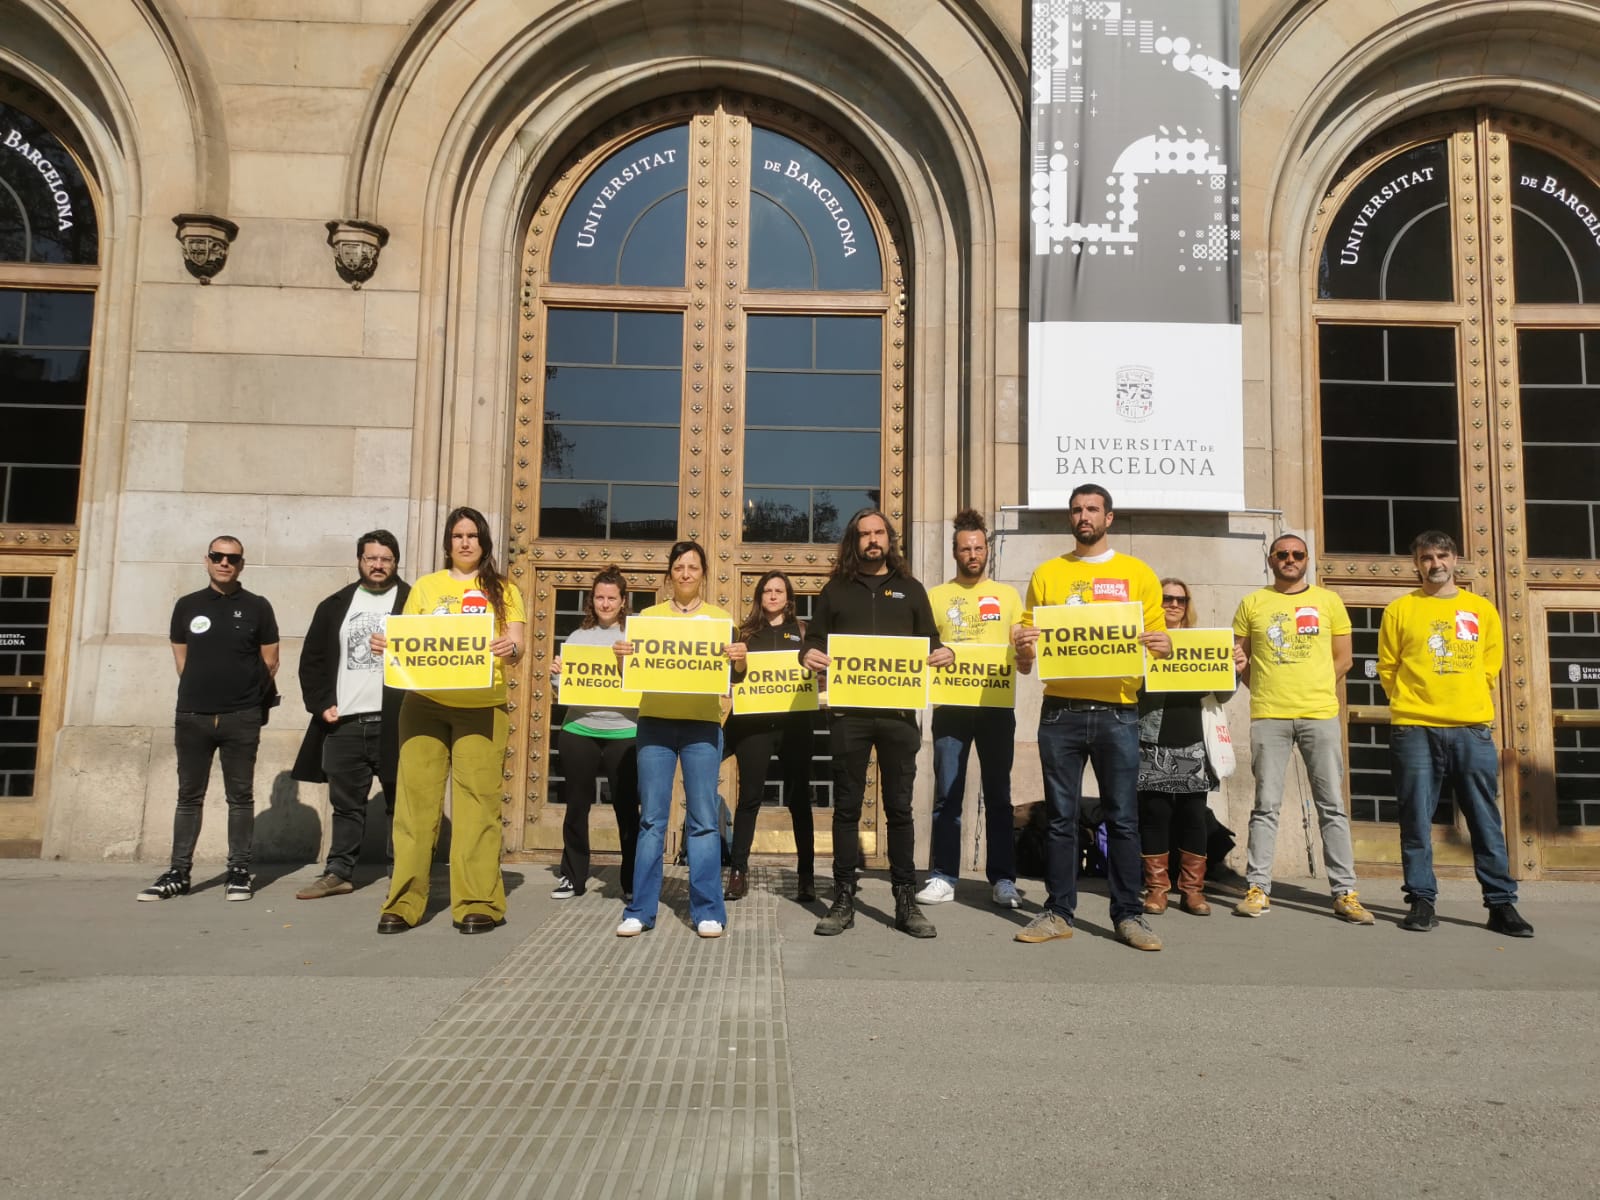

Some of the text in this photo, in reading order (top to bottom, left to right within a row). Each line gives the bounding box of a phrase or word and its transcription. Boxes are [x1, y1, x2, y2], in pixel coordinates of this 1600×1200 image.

[3, 129, 73, 232] BARCELONA
[577, 149, 857, 258] UNIVERSITAT DE BARCELONA
[1340, 167, 1434, 266] UNIVERSITAT
[1520, 175, 1539, 188] DE
[1056, 436, 1198, 453] UNIVERSITAT
[1056, 457, 1215, 476] BARCELONA
[462, 605, 486, 613] CGT
[1041, 625, 1137, 643] TORNEU
[1298, 625, 1318, 633] CGT
[1457, 632, 1479, 641] CT
[390, 637, 486, 652] TORNEU
[631, 639, 725, 656] TORNEU
[1042, 643, 1137, 657] A NEGOCIAR
[390, 655, 485, 666] A NEGOCIAR
[1162, 648, 1229, 660] RNEU
[565, 662, 617, 676] TORN
[630, 657, 723, 671] A NEGOCIAR
[833, 657, 923, 673] TORNEU
[1150, 663, 1229, 672] A NEGOCIAR
[564, 677, 573, 686] A
[748, 669, 812, 683] ORNEU
[833, 674, 921, 687] A NEGOCIAR
[932, 676, 1010, 689] A NEGOCIAR
[738, 683, 813, 695] A NEGOCIAR
